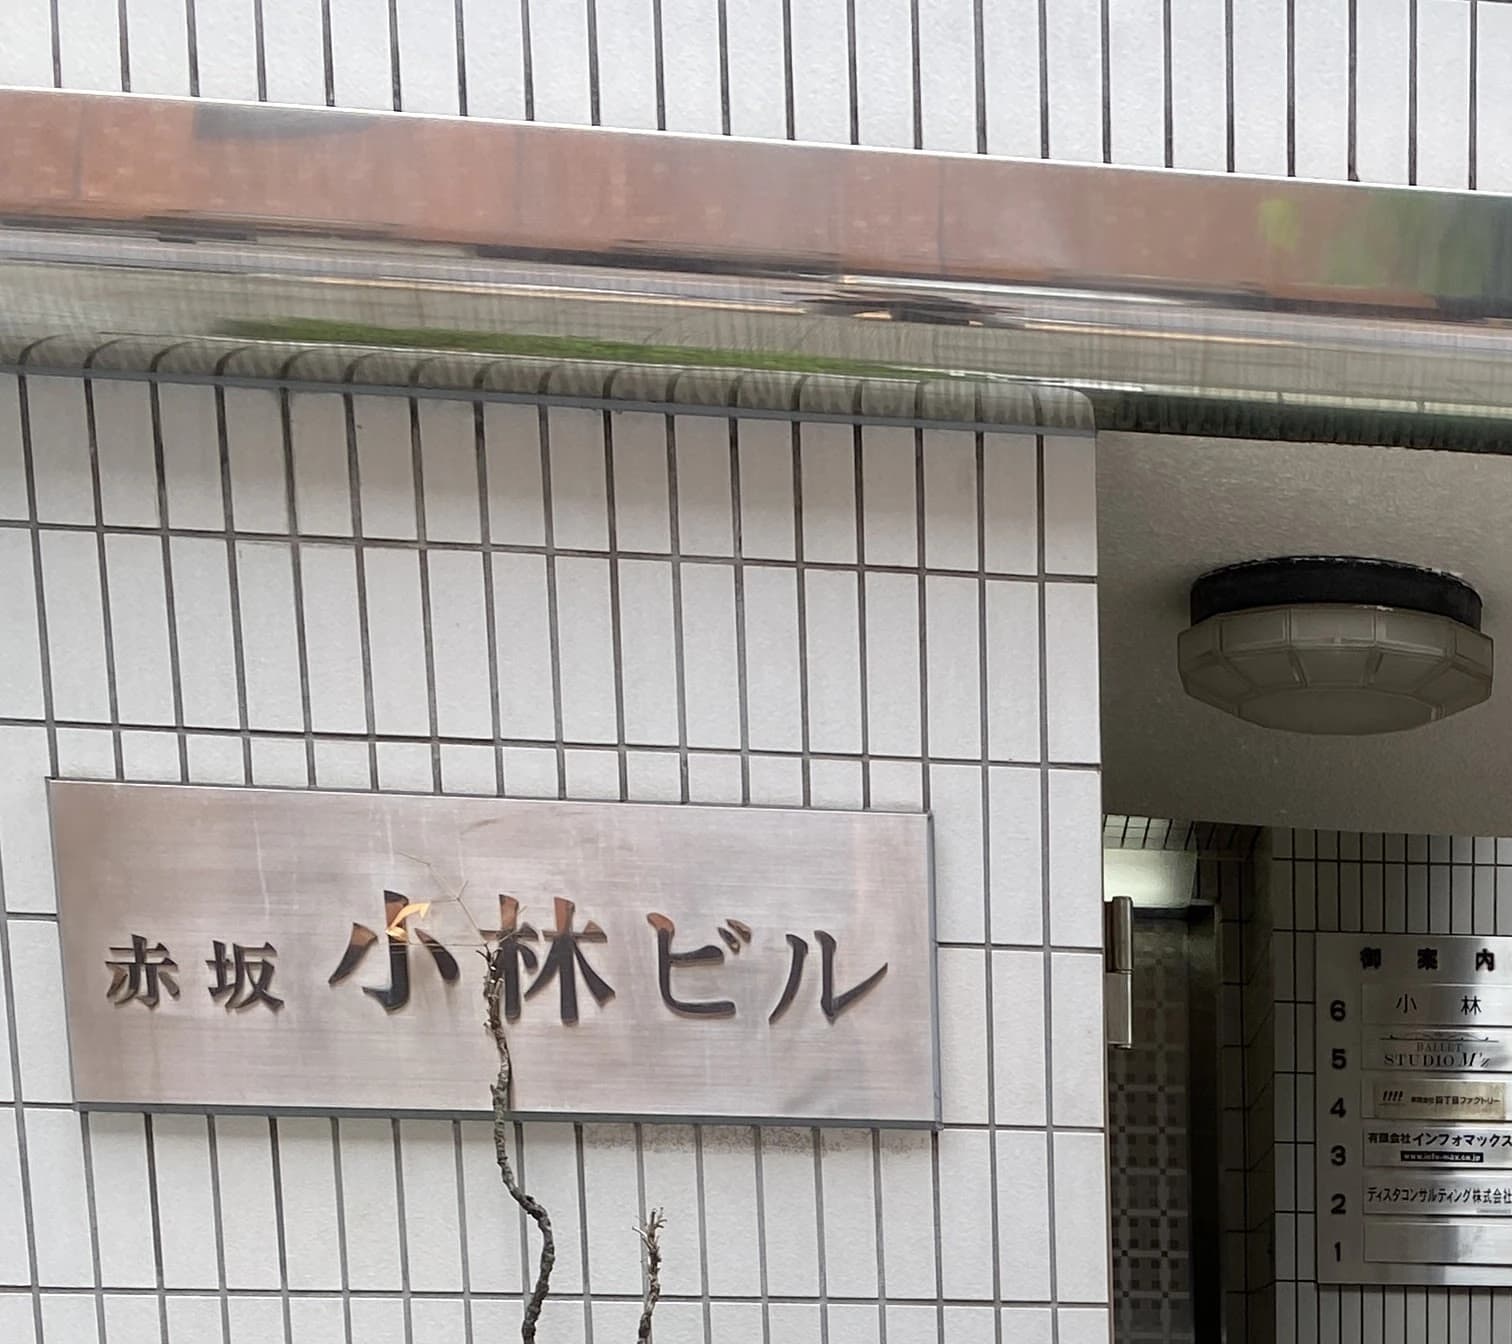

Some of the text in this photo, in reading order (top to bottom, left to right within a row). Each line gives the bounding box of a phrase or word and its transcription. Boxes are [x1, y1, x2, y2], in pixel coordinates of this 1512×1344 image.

[106, 889, 888, 1026] 赤坂 小林ビル
[1360, 947, 1495, 972] 御案内
[1330, 993, 1482, 1022] 6 小林
[1332, 1048, 1347, 1070] 5
[1384, 1053, 1455, 1069] STUDIO
[1330, 1097, 1347, 1118] 4
[1331, 1145, 1346, 1167] 3
[1331, 1187, 1512, 1215] 2 ディスタコンサルティング株式会社
[1334, 1241, 1342, 1262] 1
